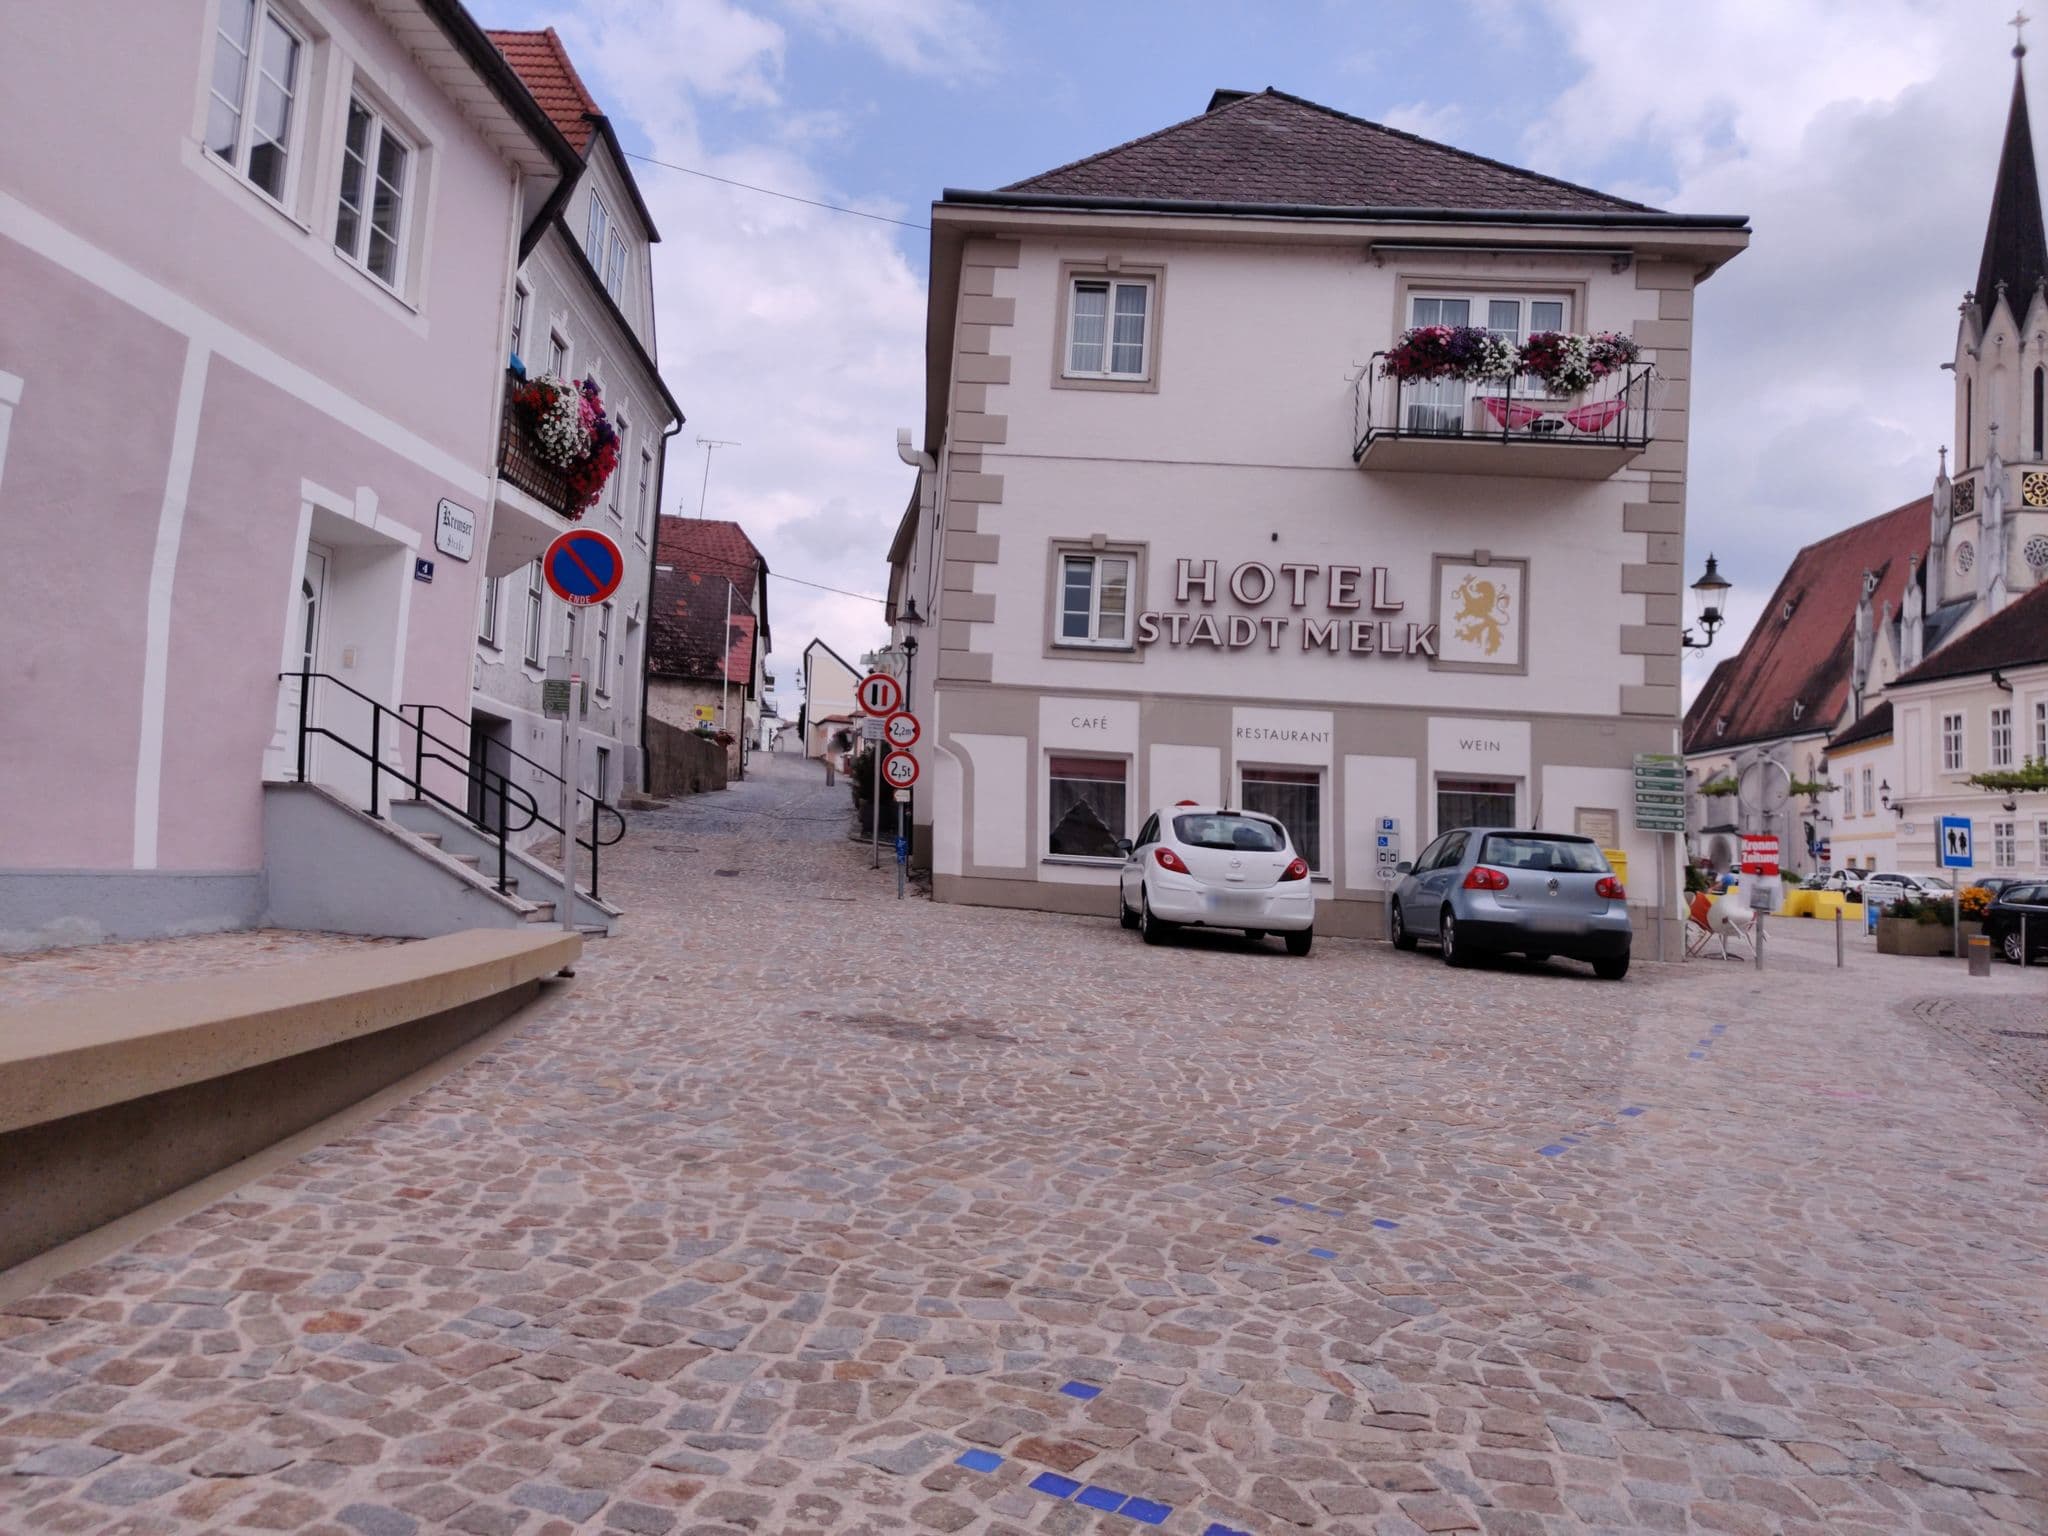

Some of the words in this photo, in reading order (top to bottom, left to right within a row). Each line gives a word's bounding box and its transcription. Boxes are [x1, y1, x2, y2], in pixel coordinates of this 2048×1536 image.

[442, 505, 472, 536] Kremser
[422, 563, 429, 574] 4
[1175, 558, 1405, 611] HOTEL
[568, 593, 591, 604] ENDE
[1137, 611, 1288, 649] STADT
[1303, 617, 1438, 656] MELK
[893, 722, 912, 738] 2,2m
[1071, 715, 1108, 730] CAFÉ
[1236, 727, 1331, 743] RESTAURANT
[1459, 739, 1501, 752] WEIN
[891, 761, 911, 778] 2,5t
[1741, 841, 1778, 851] Kronen
[1742, 852, 1779, 864] Zeitung
